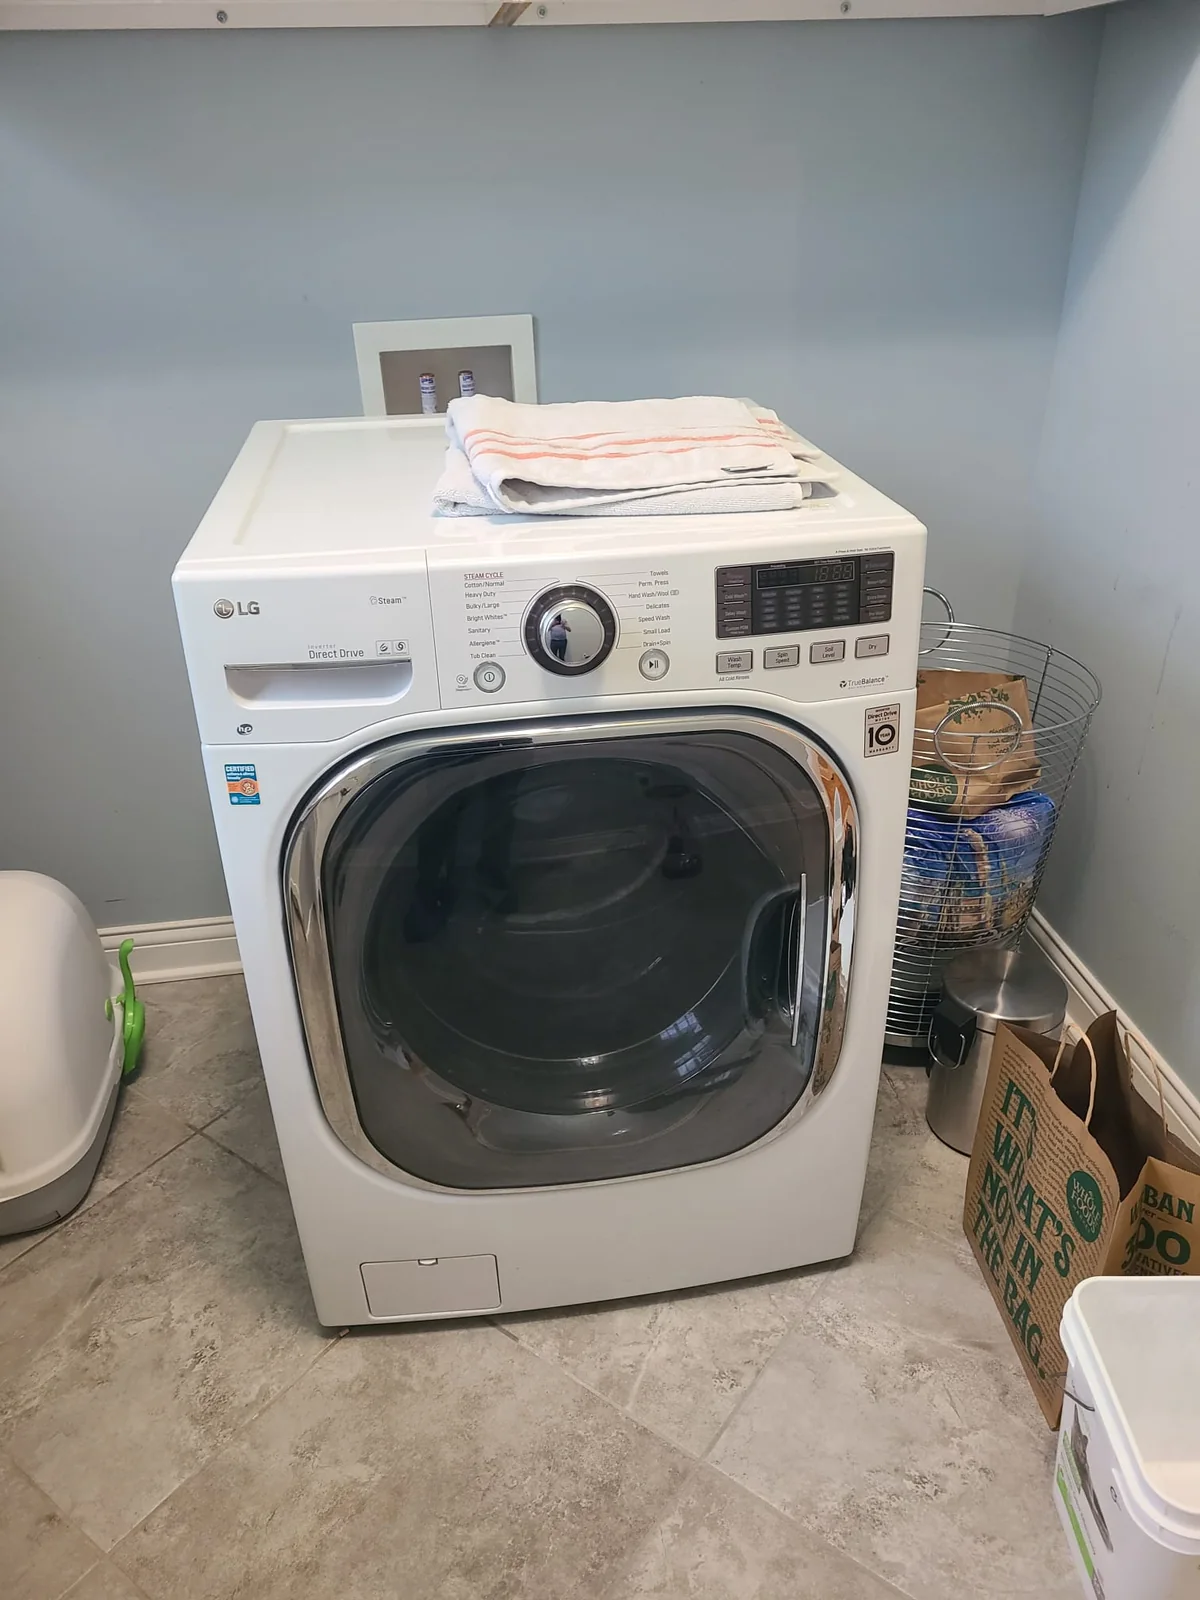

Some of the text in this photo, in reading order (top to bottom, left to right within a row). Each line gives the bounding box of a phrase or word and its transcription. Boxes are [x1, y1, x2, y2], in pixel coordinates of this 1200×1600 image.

[464, 580, 505, 588] Cotton/Normal
[465, 591, 482, 599] Heavy
[485, 571, 504, 579] CYCLE
[237, 600, 261, 616] LG
[308, 647, 365, 659] Direct Drive
[868, 712, 883, 720] Direct
[868, 723, 896, 748] 10
[981, 1160, 1015, 1241] NOT
[993, 1118, 1077, 1278] WHAT'S
[1071, 1189, 1098, 1234] FOODS
[1073, 1178, 1101, 1224] WHOLE
[1144, 1184, 1196, 1225] BAN
[972, 1198, 1005, 1287] THE
[1011, 1230, 1044, 1294] IN
[1003, 1272, 1046, 1380] BAG.
